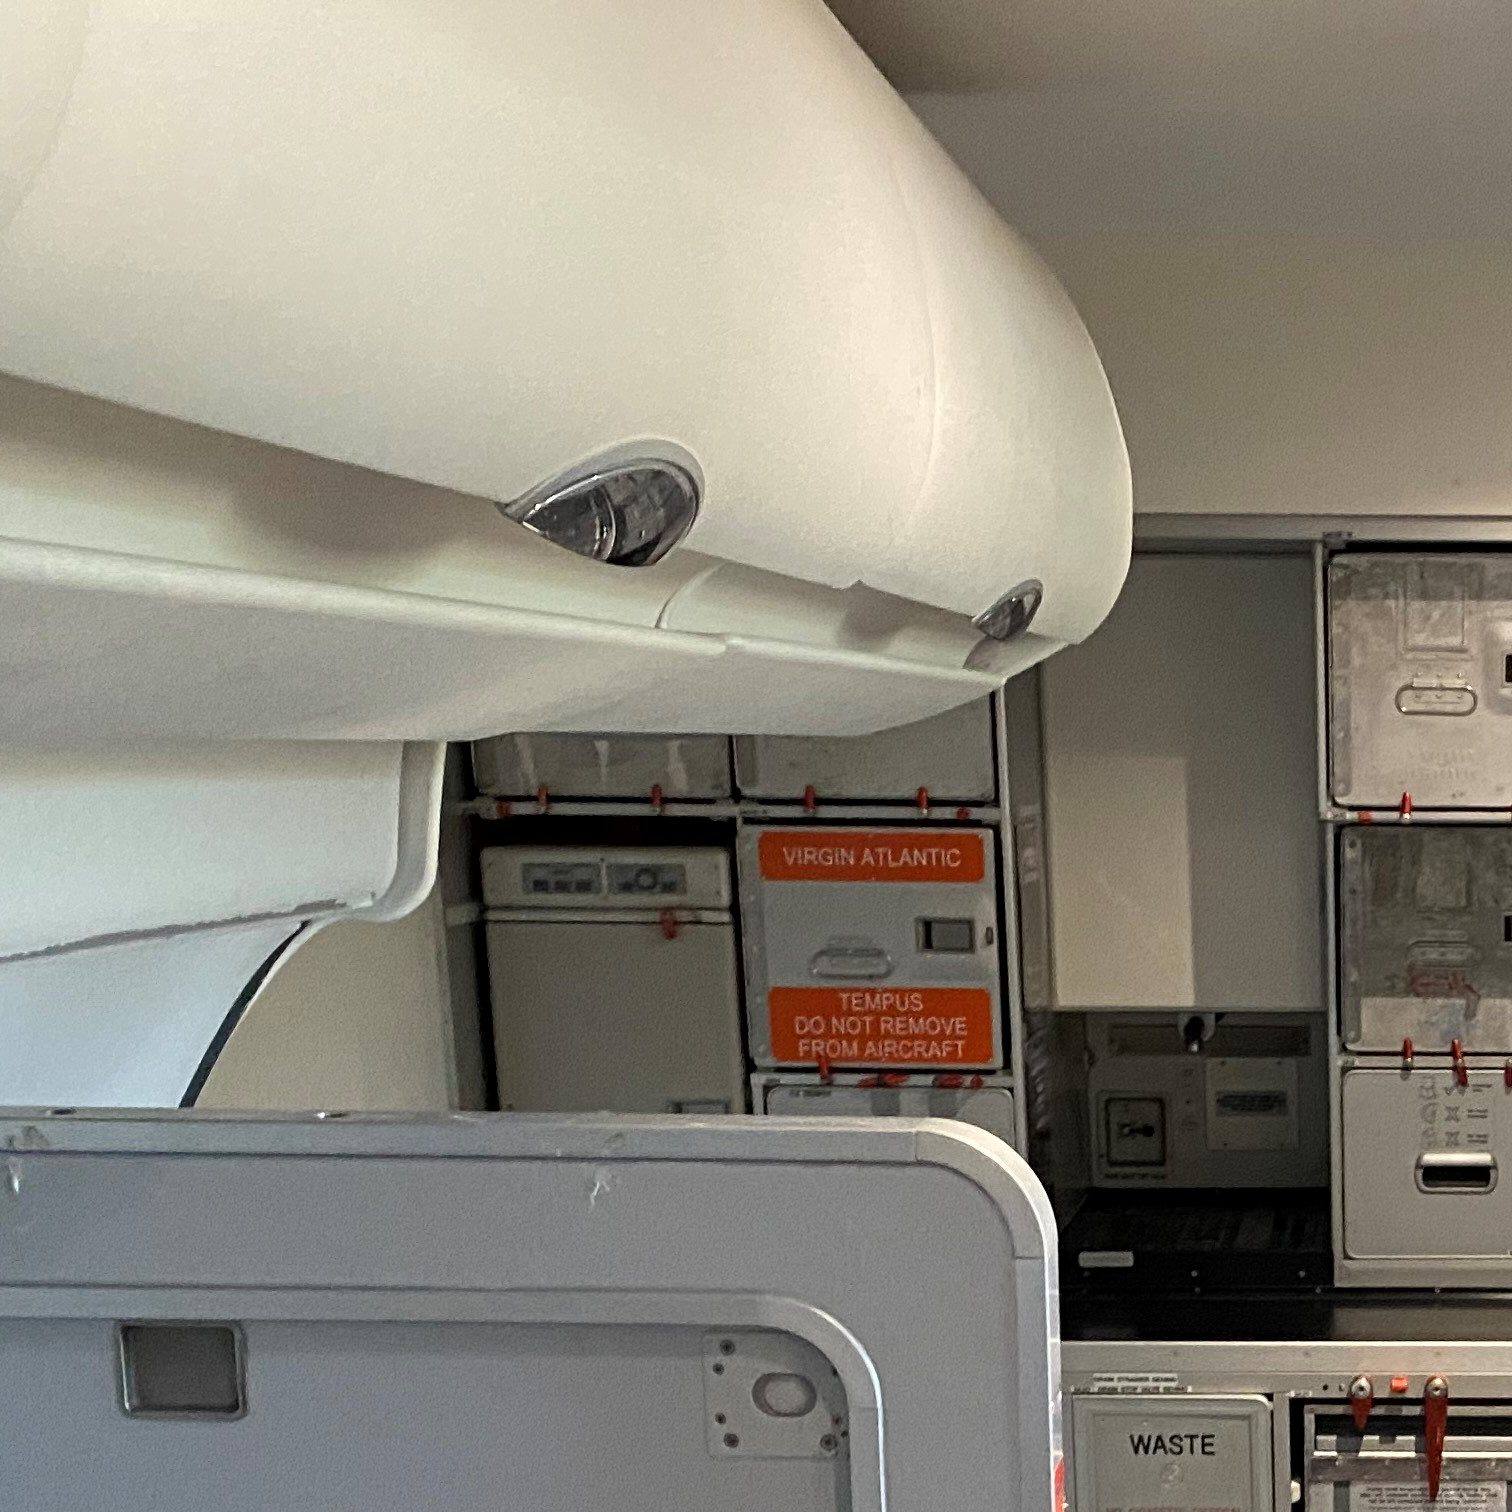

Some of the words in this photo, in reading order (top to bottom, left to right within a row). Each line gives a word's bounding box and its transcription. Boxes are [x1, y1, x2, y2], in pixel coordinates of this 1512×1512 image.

[782, 847, 855, 867] VIRGIN
[860, 847, 962, 867] ATLANTIC
[839, 992, 924, 1011] TEMPUS
[794, 1016, 825, 1035] DO
[831, 1016, 877, 1035] NOT
[880, 1016, 968, 1036] REMOVE
[798, 1039, 857, 1058] FROM
[864, 1039, 966, 1059] AIRCRAFT
[1129, 1433, 1216, 1456] WASTE
